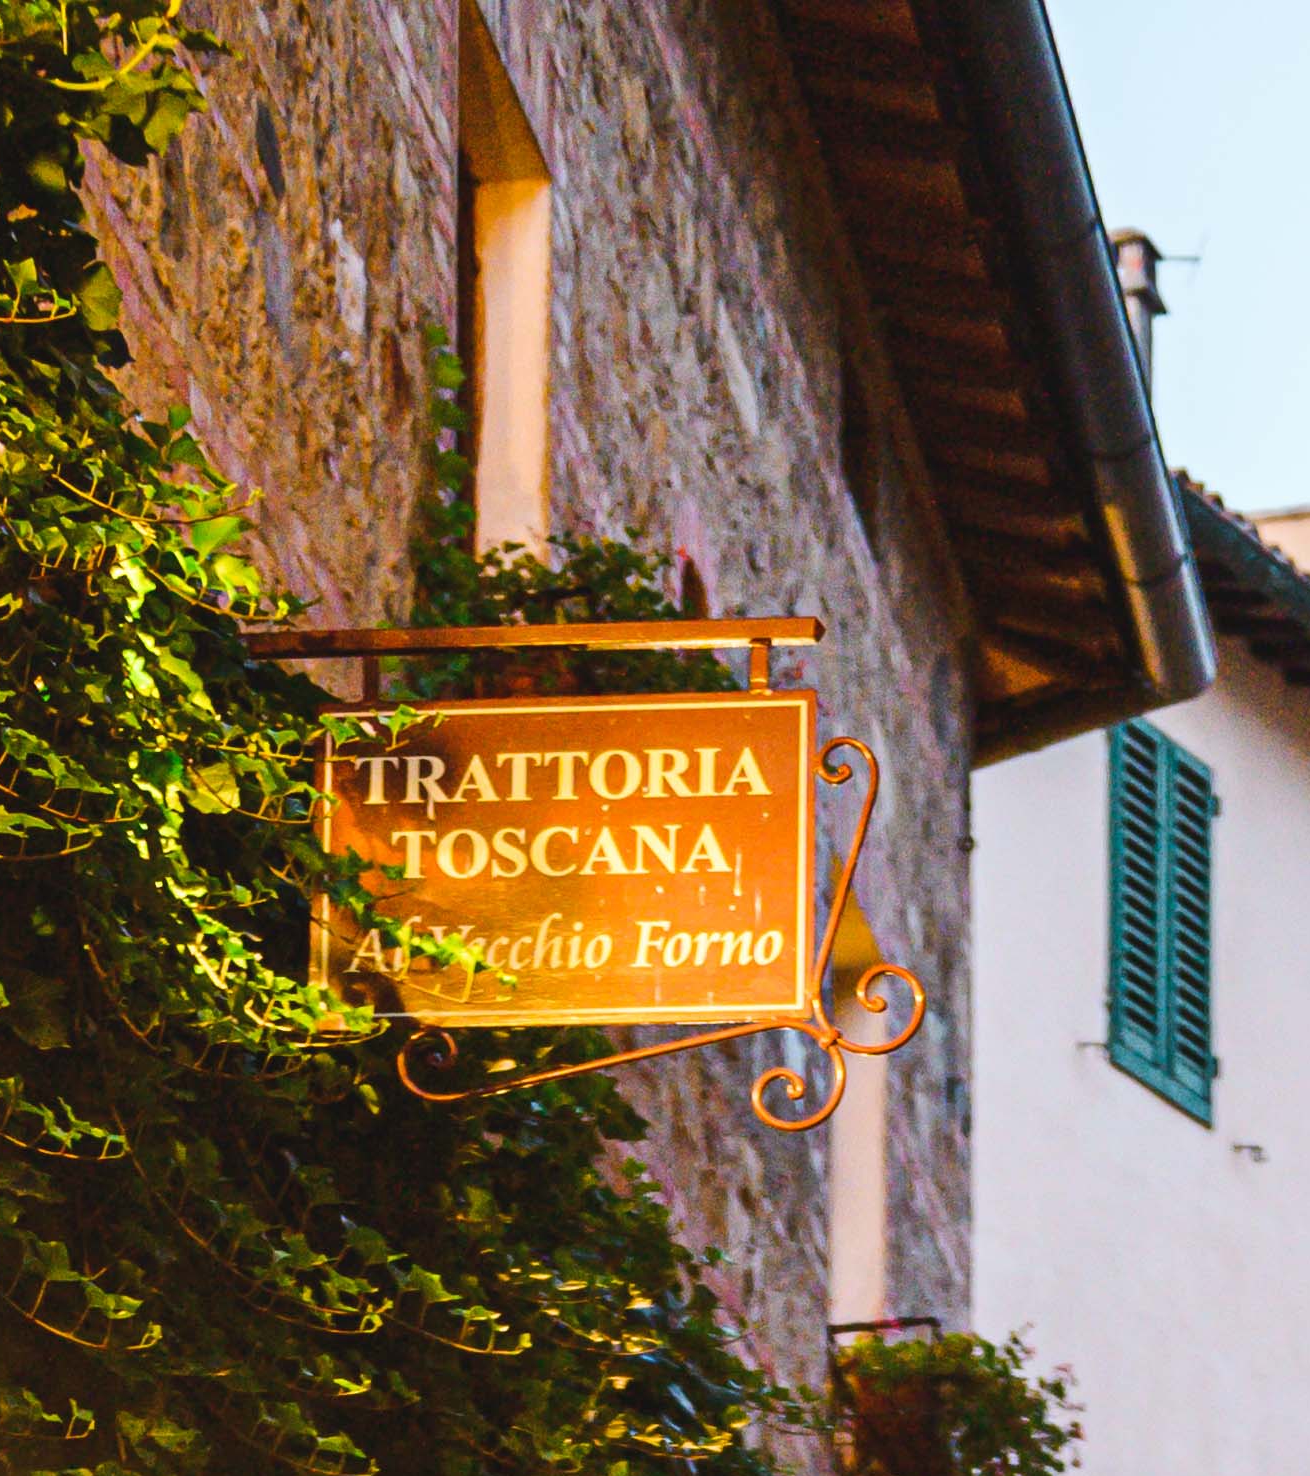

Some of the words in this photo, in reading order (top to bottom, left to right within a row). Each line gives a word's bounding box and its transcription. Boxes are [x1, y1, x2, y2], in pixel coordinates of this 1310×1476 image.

[355, 747, 772, 806] TRATTORIA
[392, 824, 732, 880] TOSCANA
[634, 920, 783, 969] Forno
